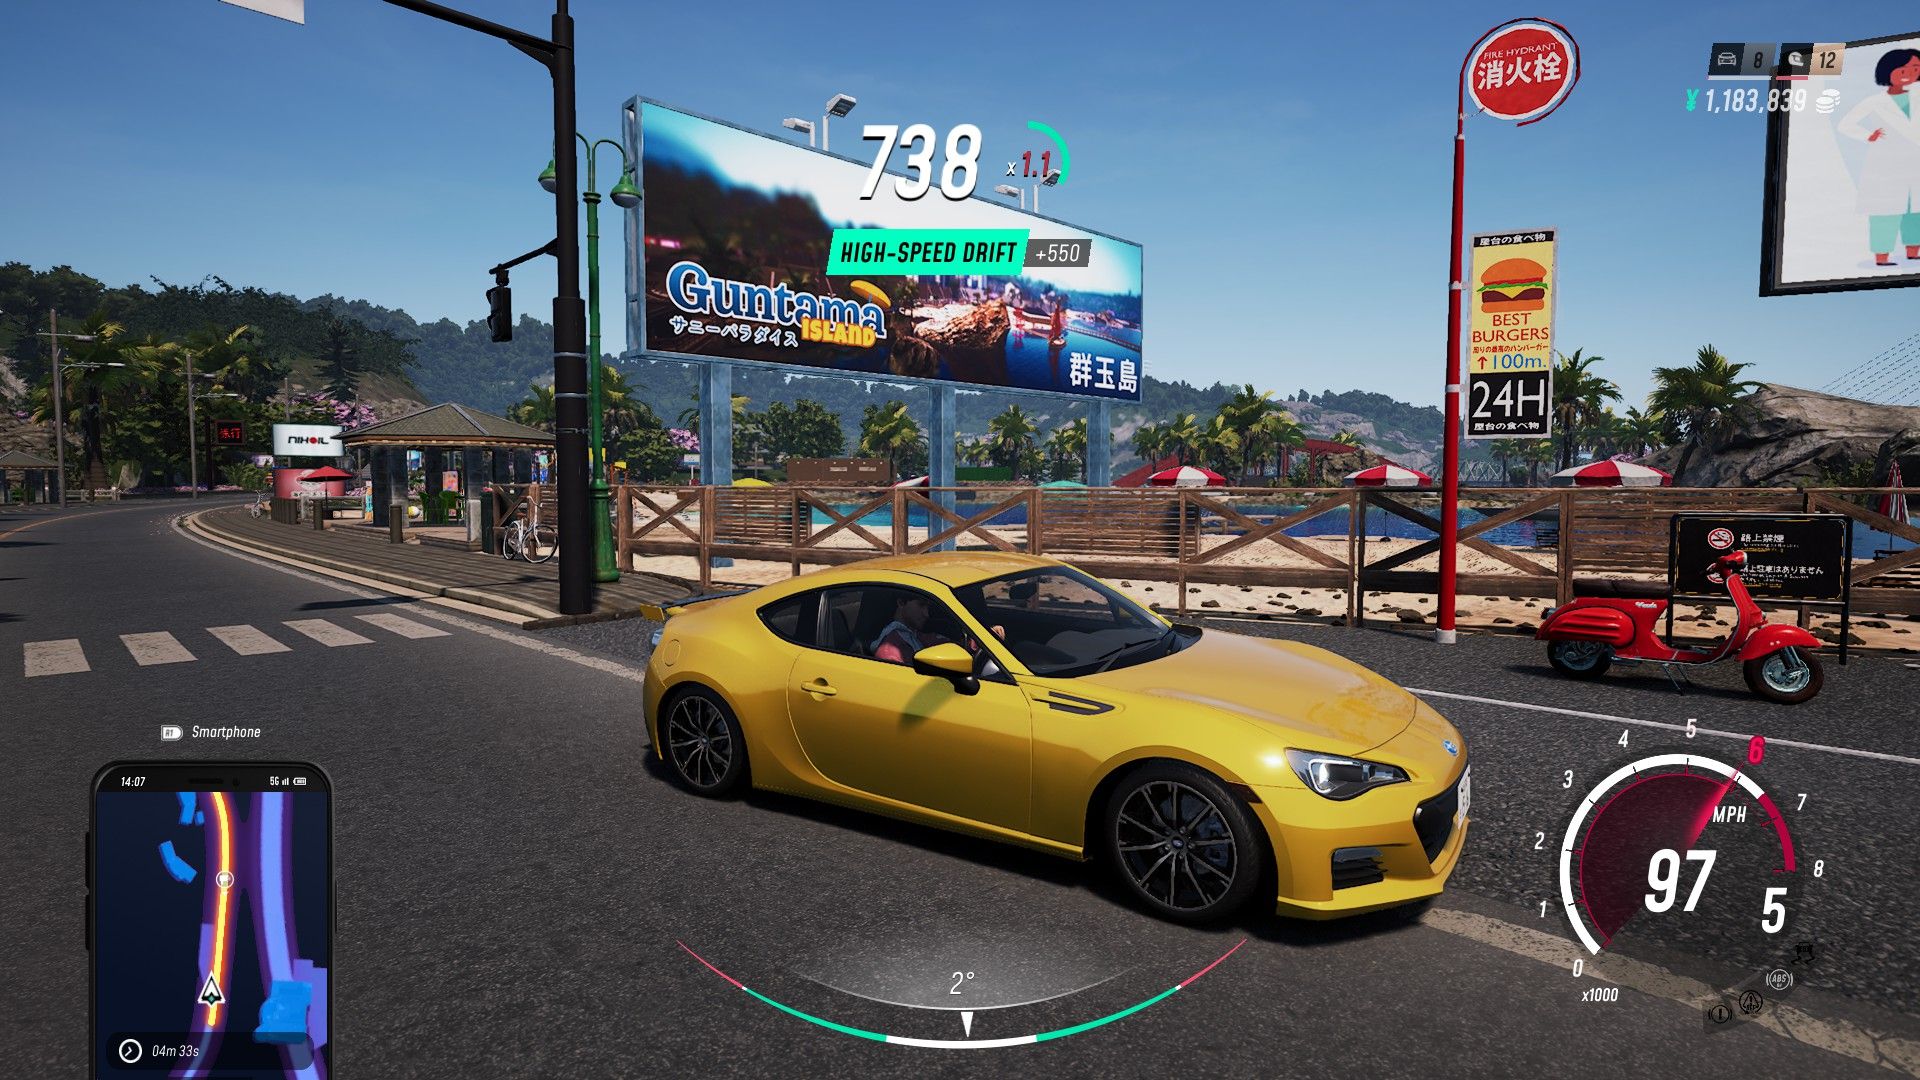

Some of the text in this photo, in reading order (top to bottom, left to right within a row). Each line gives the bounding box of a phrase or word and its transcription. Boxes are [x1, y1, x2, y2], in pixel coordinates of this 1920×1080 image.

[1483, 42, 1558, 60] FIRE HYDRANT
[1477, 51, 1562, 90] 消火栓
[1479, 232, 1546, 246] 屋台の食べ物
[666, 260, 887, 340] Guntama
[669, 316, 799, 348] サニーパラダイス
[1492, 312, 1532, 327] BEST
[1472, 327, 1549, 343] BURGERS
[1070, 352, 1138, 394] 群玉島
[1472, 379, 1545, 418] 24H
[1473, 421, 1540, 431] 屋台の食べ物
